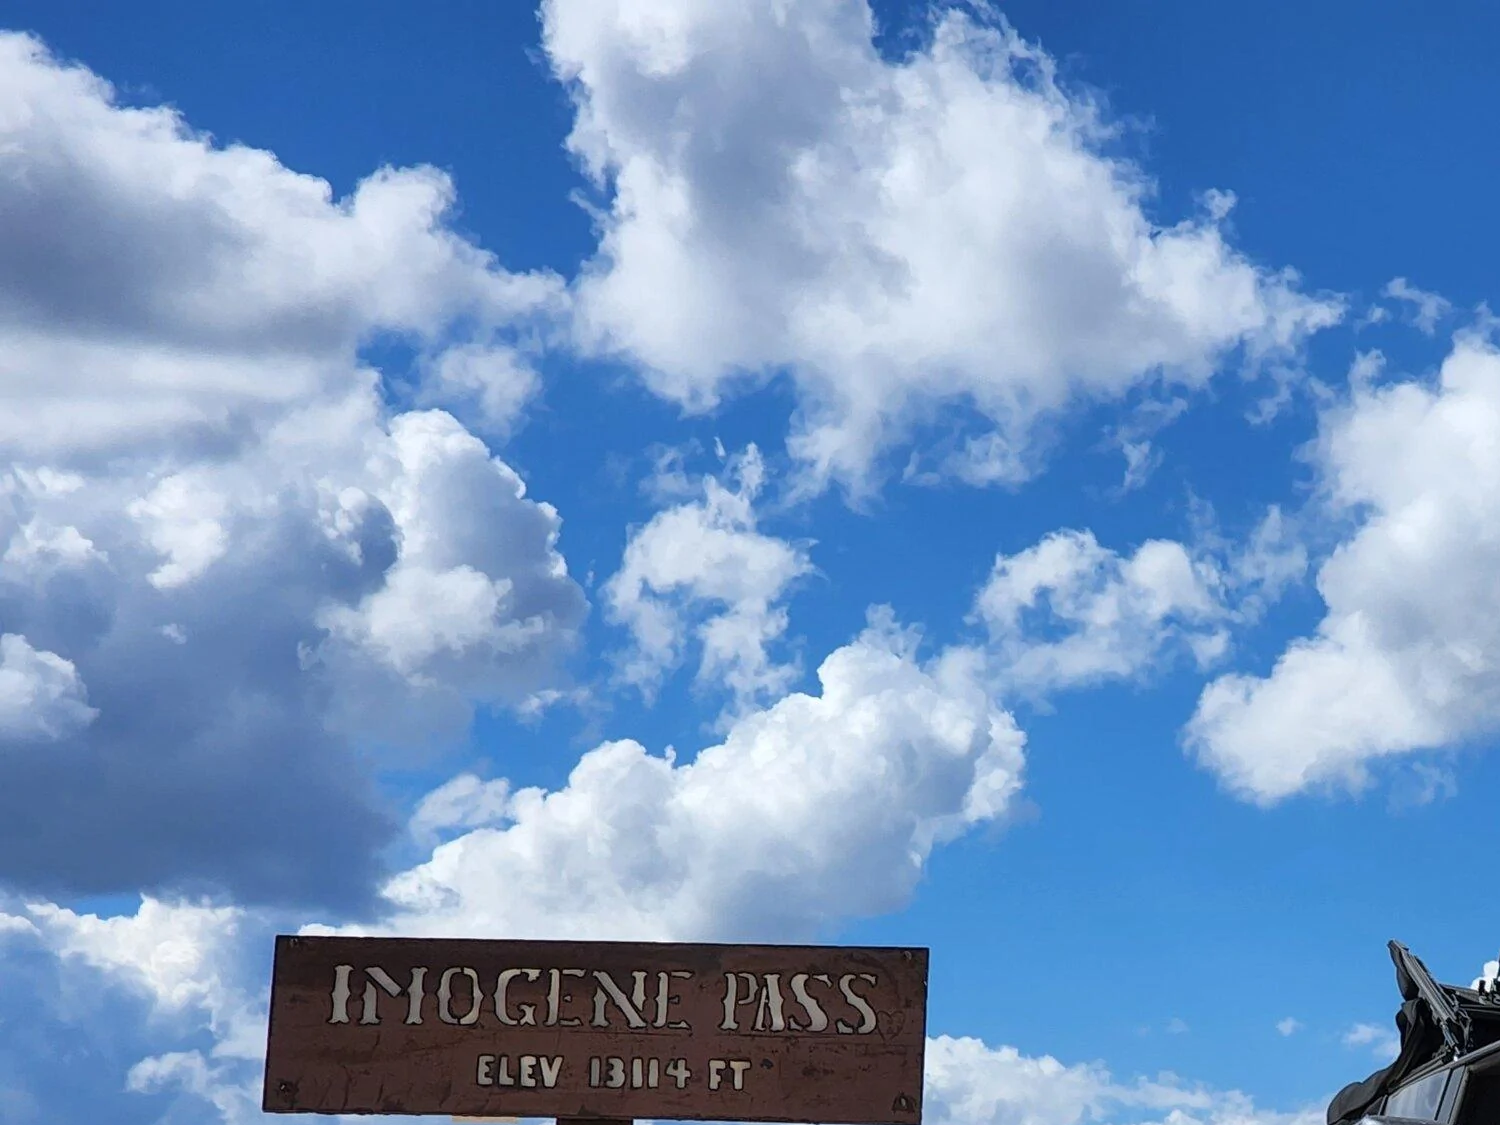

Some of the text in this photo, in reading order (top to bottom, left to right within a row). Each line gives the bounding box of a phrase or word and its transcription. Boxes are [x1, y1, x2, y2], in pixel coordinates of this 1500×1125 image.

[328, 964, 878, 1035] IMOGENE PASS
[476, 1055, 752, 1091] ELEV 13114 FT
